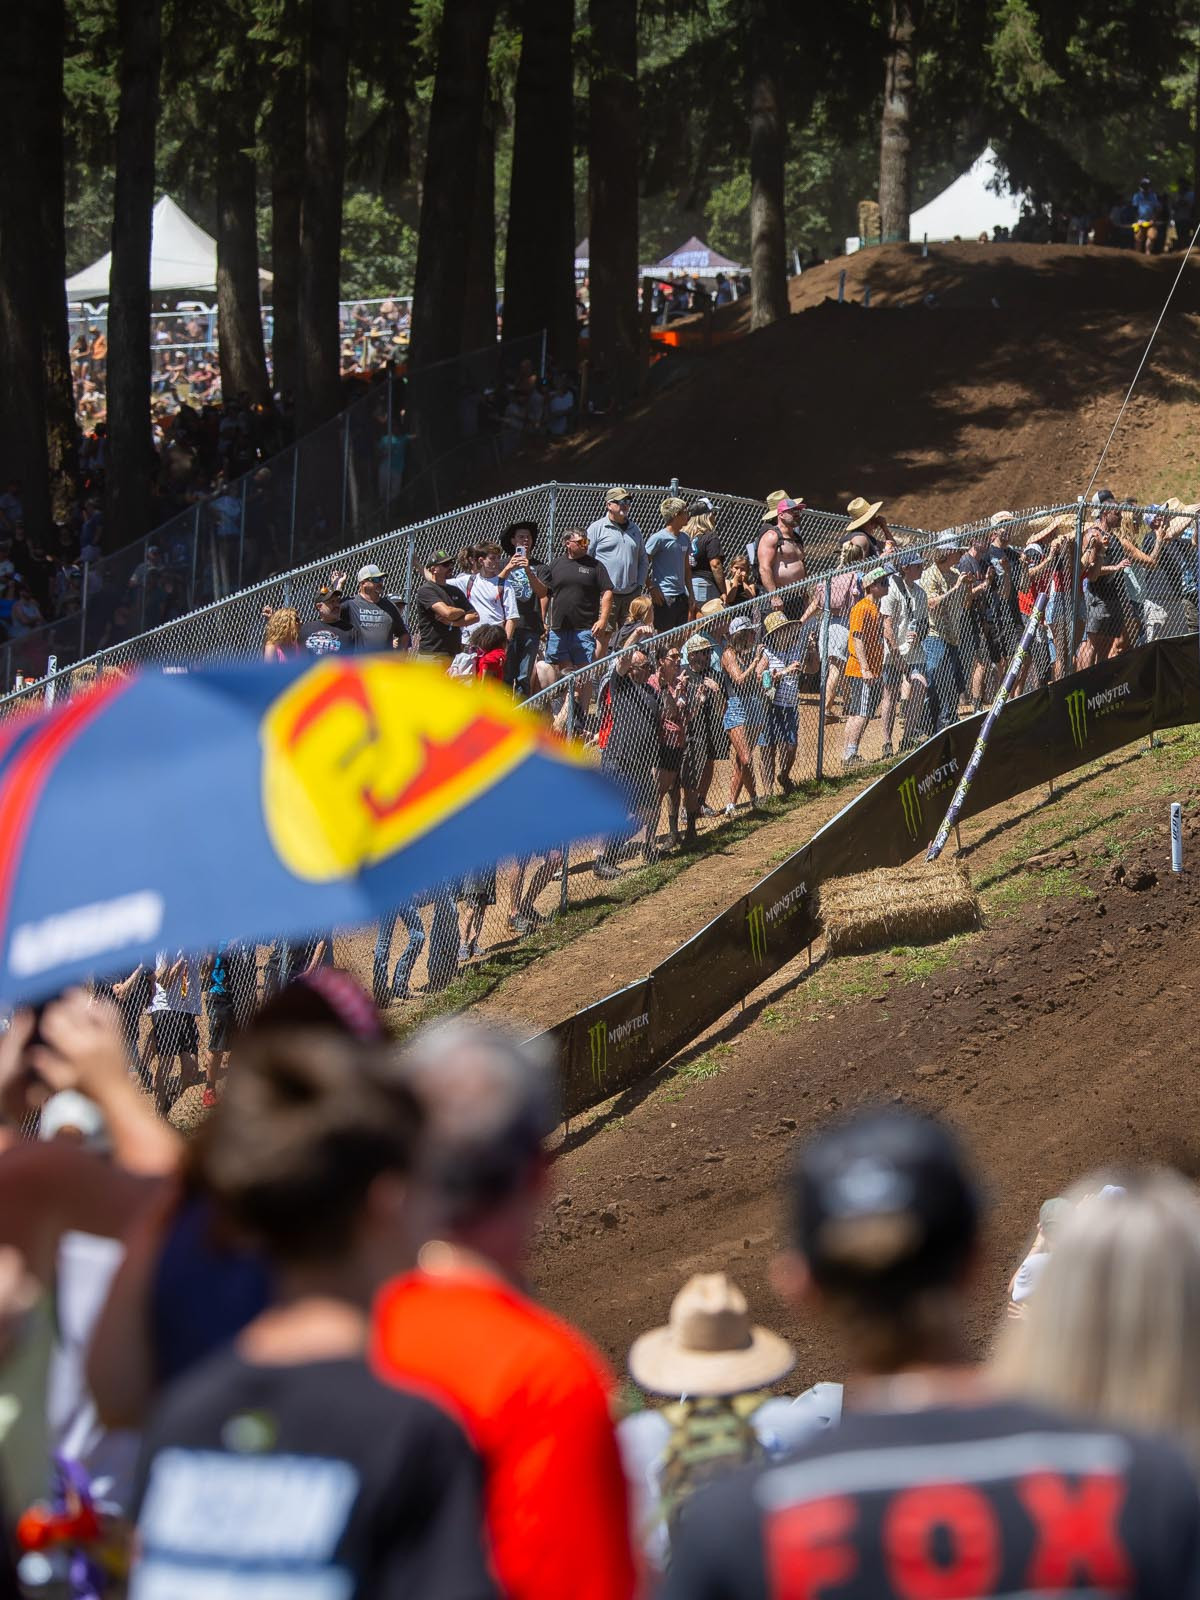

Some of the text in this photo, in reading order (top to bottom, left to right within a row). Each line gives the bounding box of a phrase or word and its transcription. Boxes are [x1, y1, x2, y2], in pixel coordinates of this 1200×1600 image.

[1087, 682, 1130, 710] MONSTER
[917, 758, 959, 795] MONSTR
[765, 881, 807, 922] MONSTER
[608, 1012, 649, 1044] MONSTER
[763, 1467, 1135, 1600] FOX
